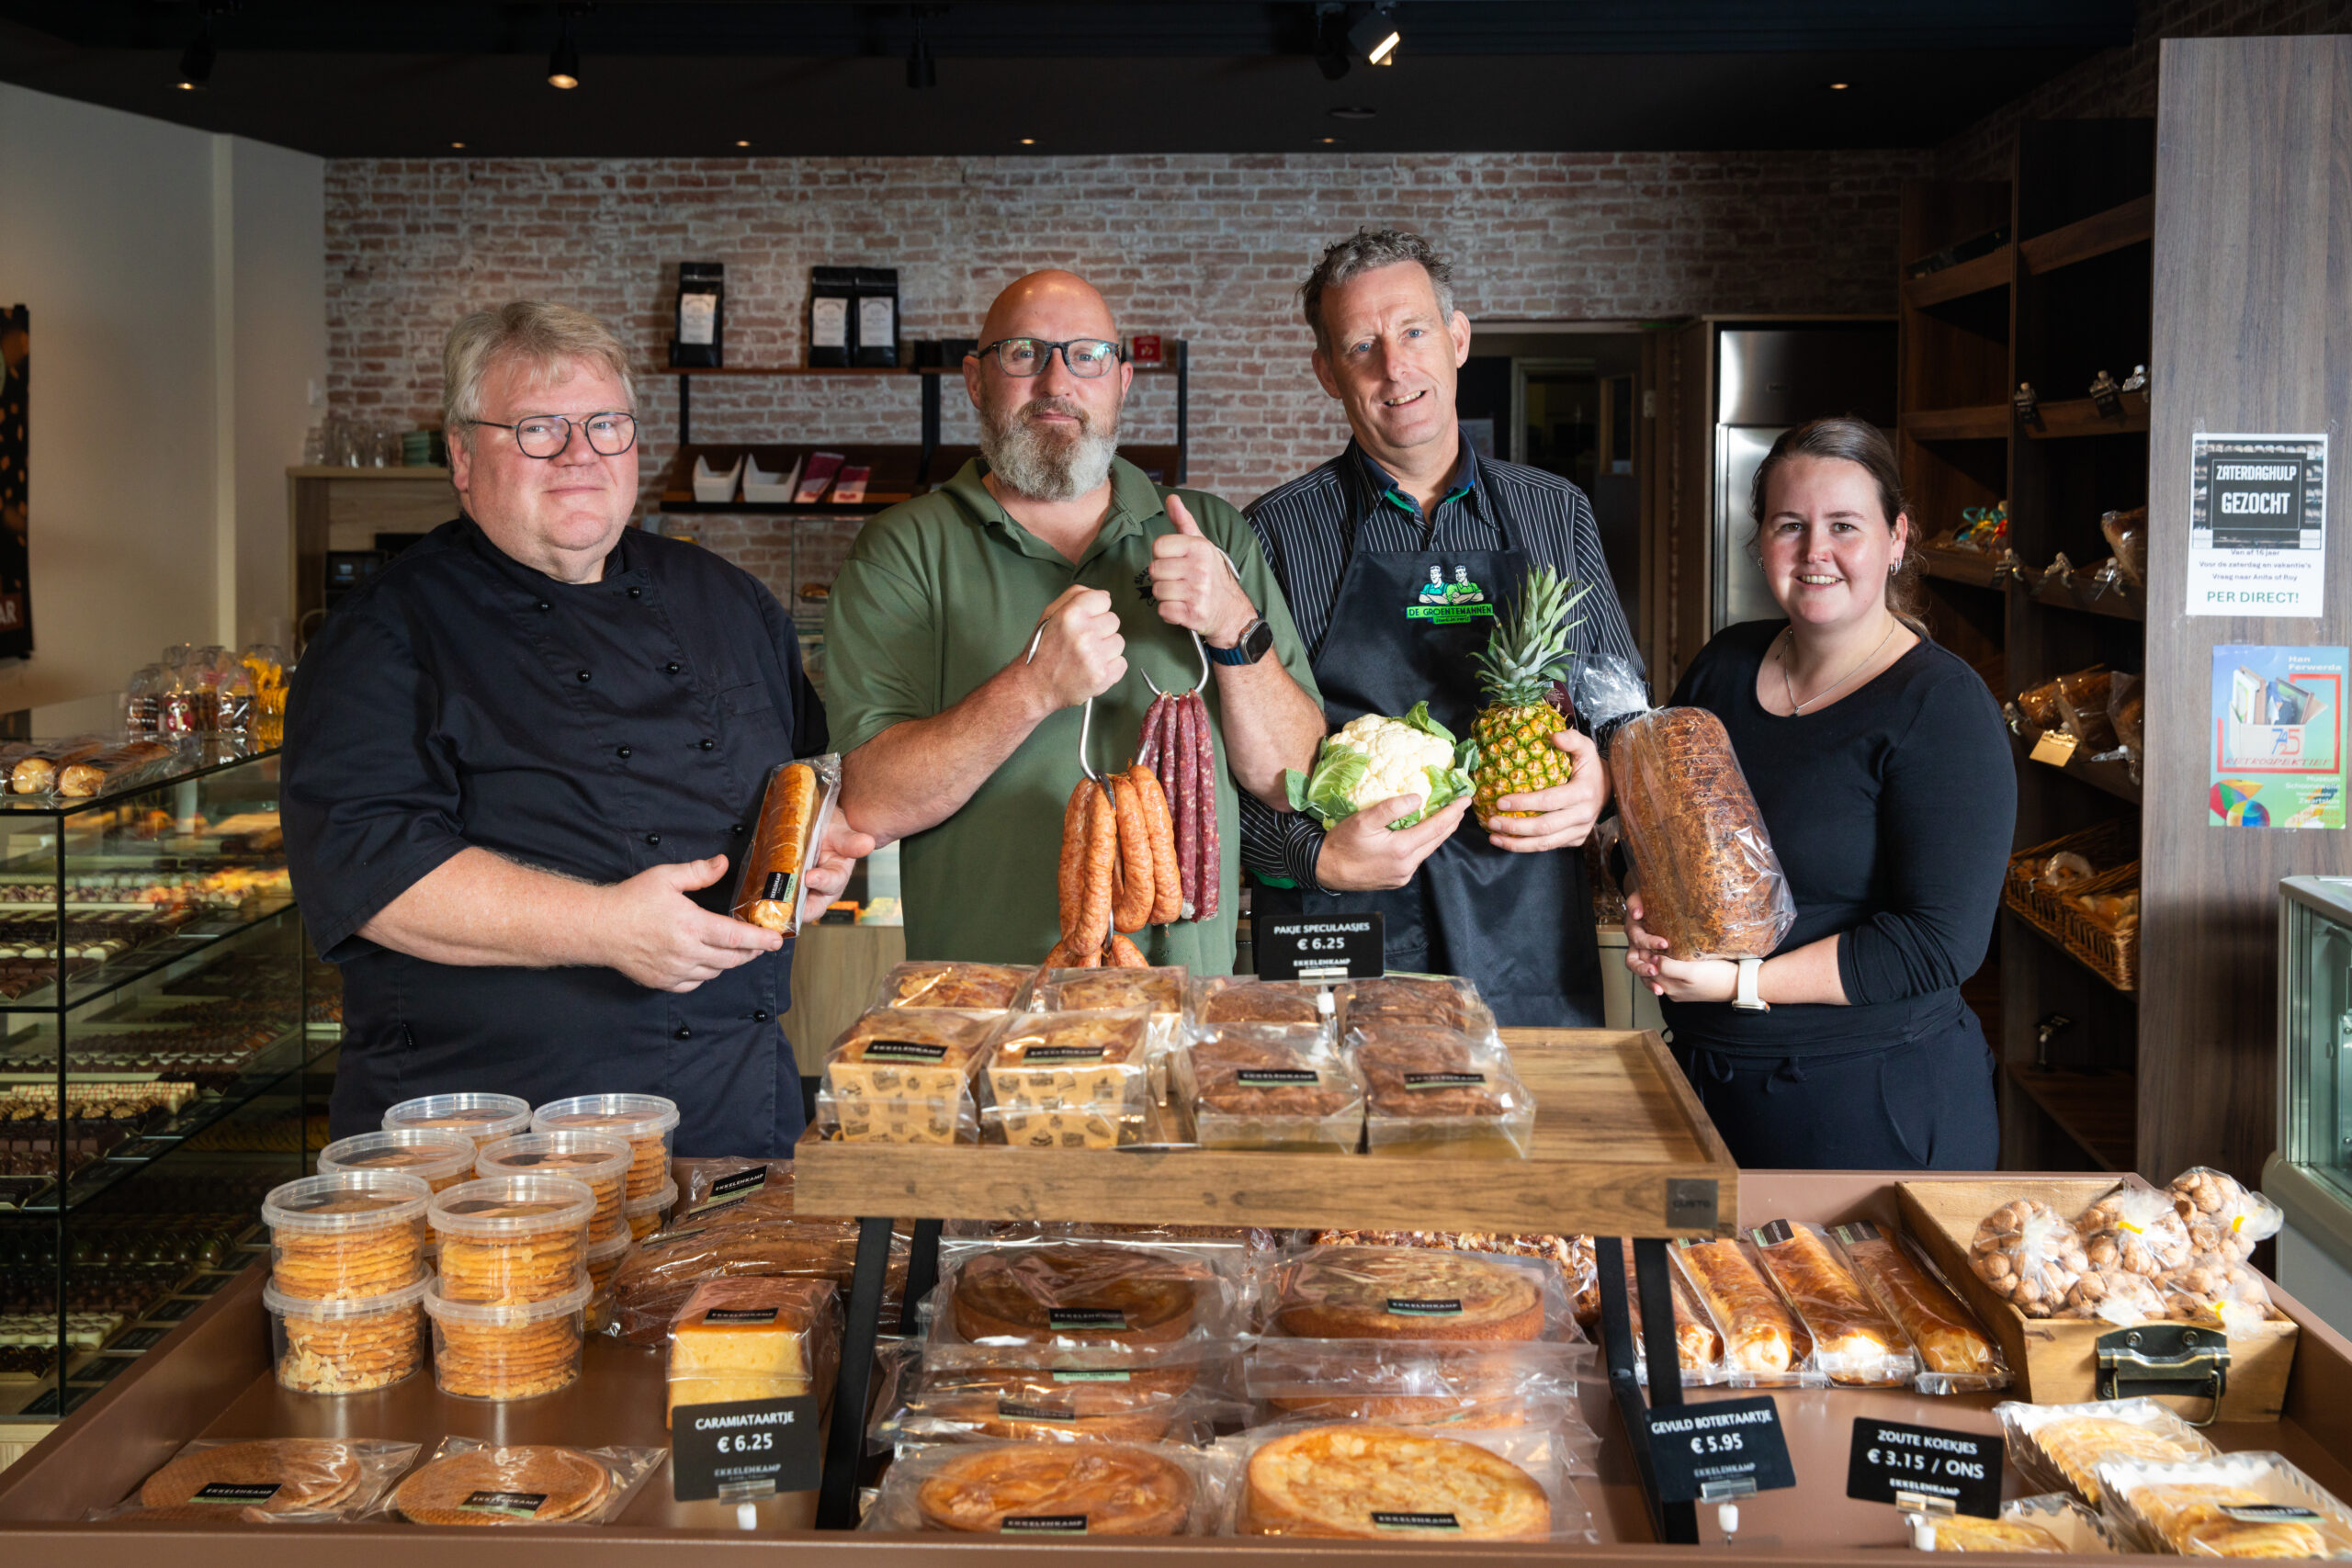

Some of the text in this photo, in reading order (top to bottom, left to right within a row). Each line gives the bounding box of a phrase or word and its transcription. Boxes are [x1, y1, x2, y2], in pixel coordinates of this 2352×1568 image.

[2216, 465, 2297, 481] ZATERDAGHULP
[2221, 491, 2290, 514] GEZOCHT
[2228, 561, 2261, 570] zaterdag
[2212, 573, 2233, 581] Vraag
[2207, 591, 2300, 604] PER DIRECT!
[1408, 606, 1492, 616] DE GROENTEMANNEN
[1273, 922, 1370, 935] PAKJE SPECULAASJES
[1296, 937, 1345, 951] € 6.25
[1293, 958, 1351, 967] EKKELENKAMP
[715, 1173, 764, 1191] EKKELENKAMP
[695, 1411, 795, 1431] CARAMIATAARTJE
[1651, 1409, 1772, 1435] GEVULD BOTERTAARTJE
[717, 1432, 773, 1453] € 6.25
[1690, 1432, 1744, 1454] € 5.95
[1877, 1428, 1978, 1455] ZOUTE KOEKJES
[714, 1463, 781, 1477] EKKELENKAMP
[1693, 1462, 1756, 1478] EKKELENKAMP
[1867, 1448, 1984, 1480] € 3.15 / ONS
[1889, 1477, 1961, 1496] EKKELENKAMP
